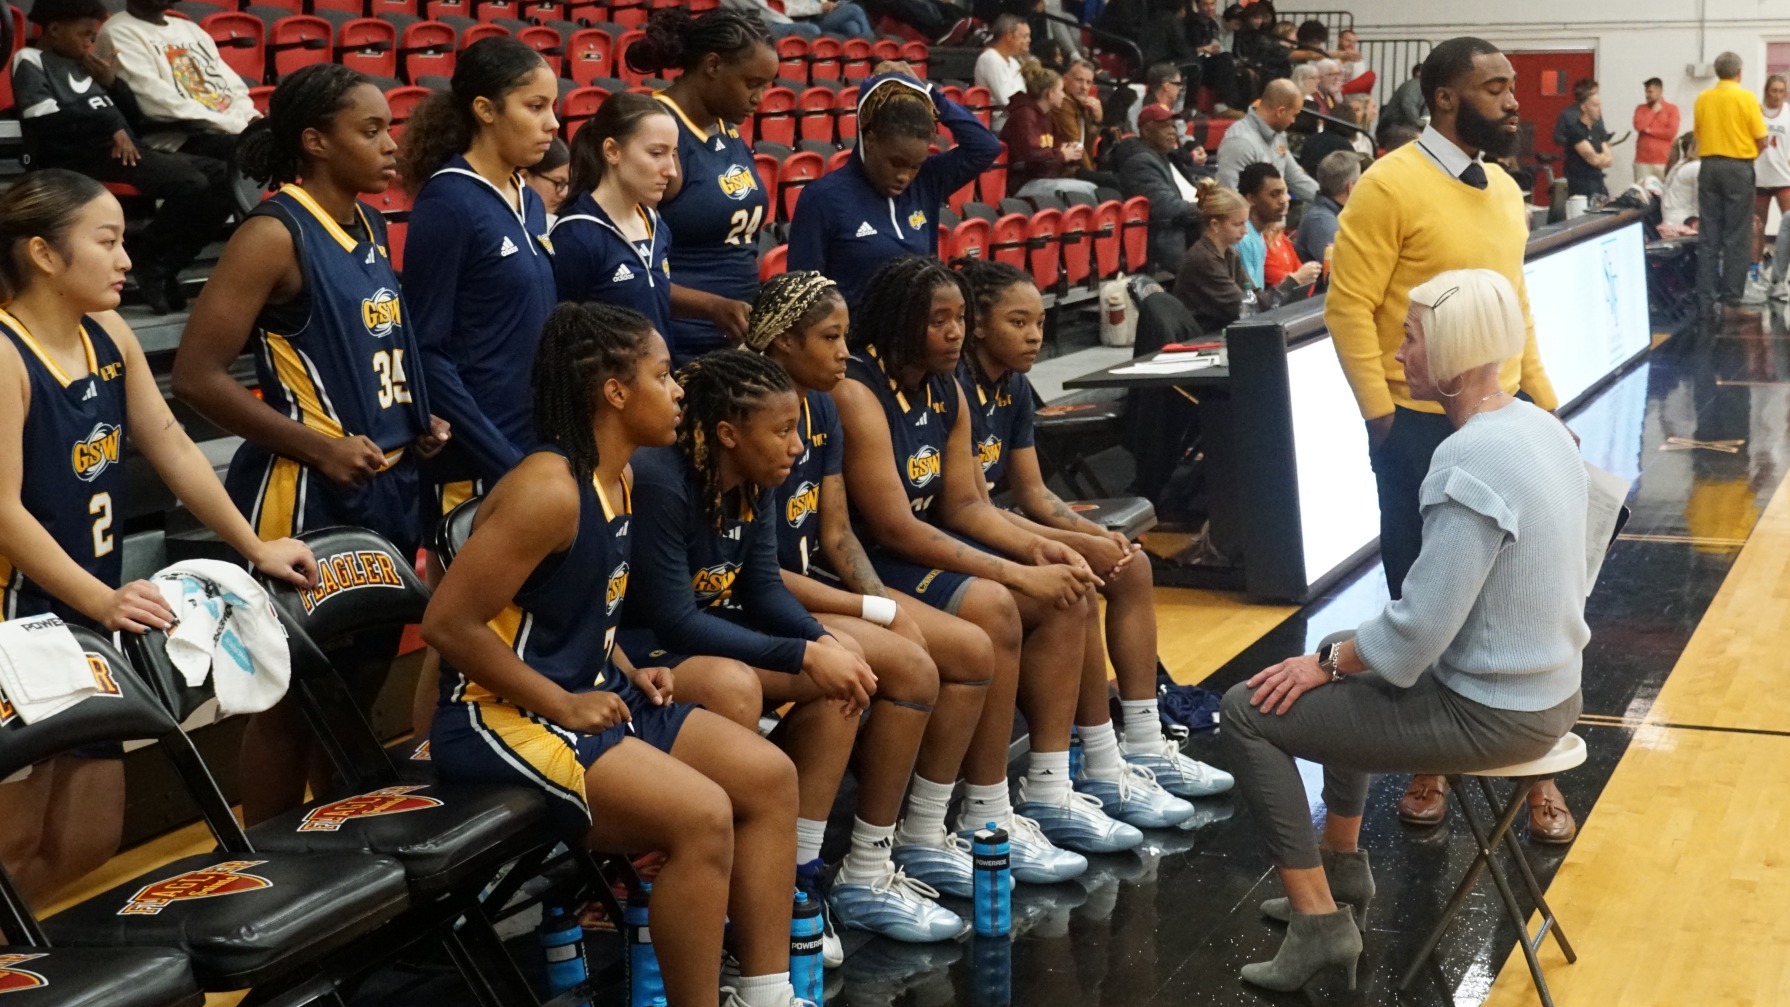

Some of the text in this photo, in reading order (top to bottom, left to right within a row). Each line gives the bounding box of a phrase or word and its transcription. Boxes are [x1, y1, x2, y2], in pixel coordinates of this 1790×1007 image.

[719, 168, 757, 195] GSW
[724, 205, 763, 246] 24
[612, 273, 635, 283] adidas
[372, 349, 412, 410] 35
[73, 427, 121, 475] GSW
[907, 452, 940, 480] GSW
[787, 484, 819, 522] GSW
[89, 490, 114, 558] 2
[976, 858, 1007, 867] POWERADE
[117, 860, 269, 915] FLAGLER
